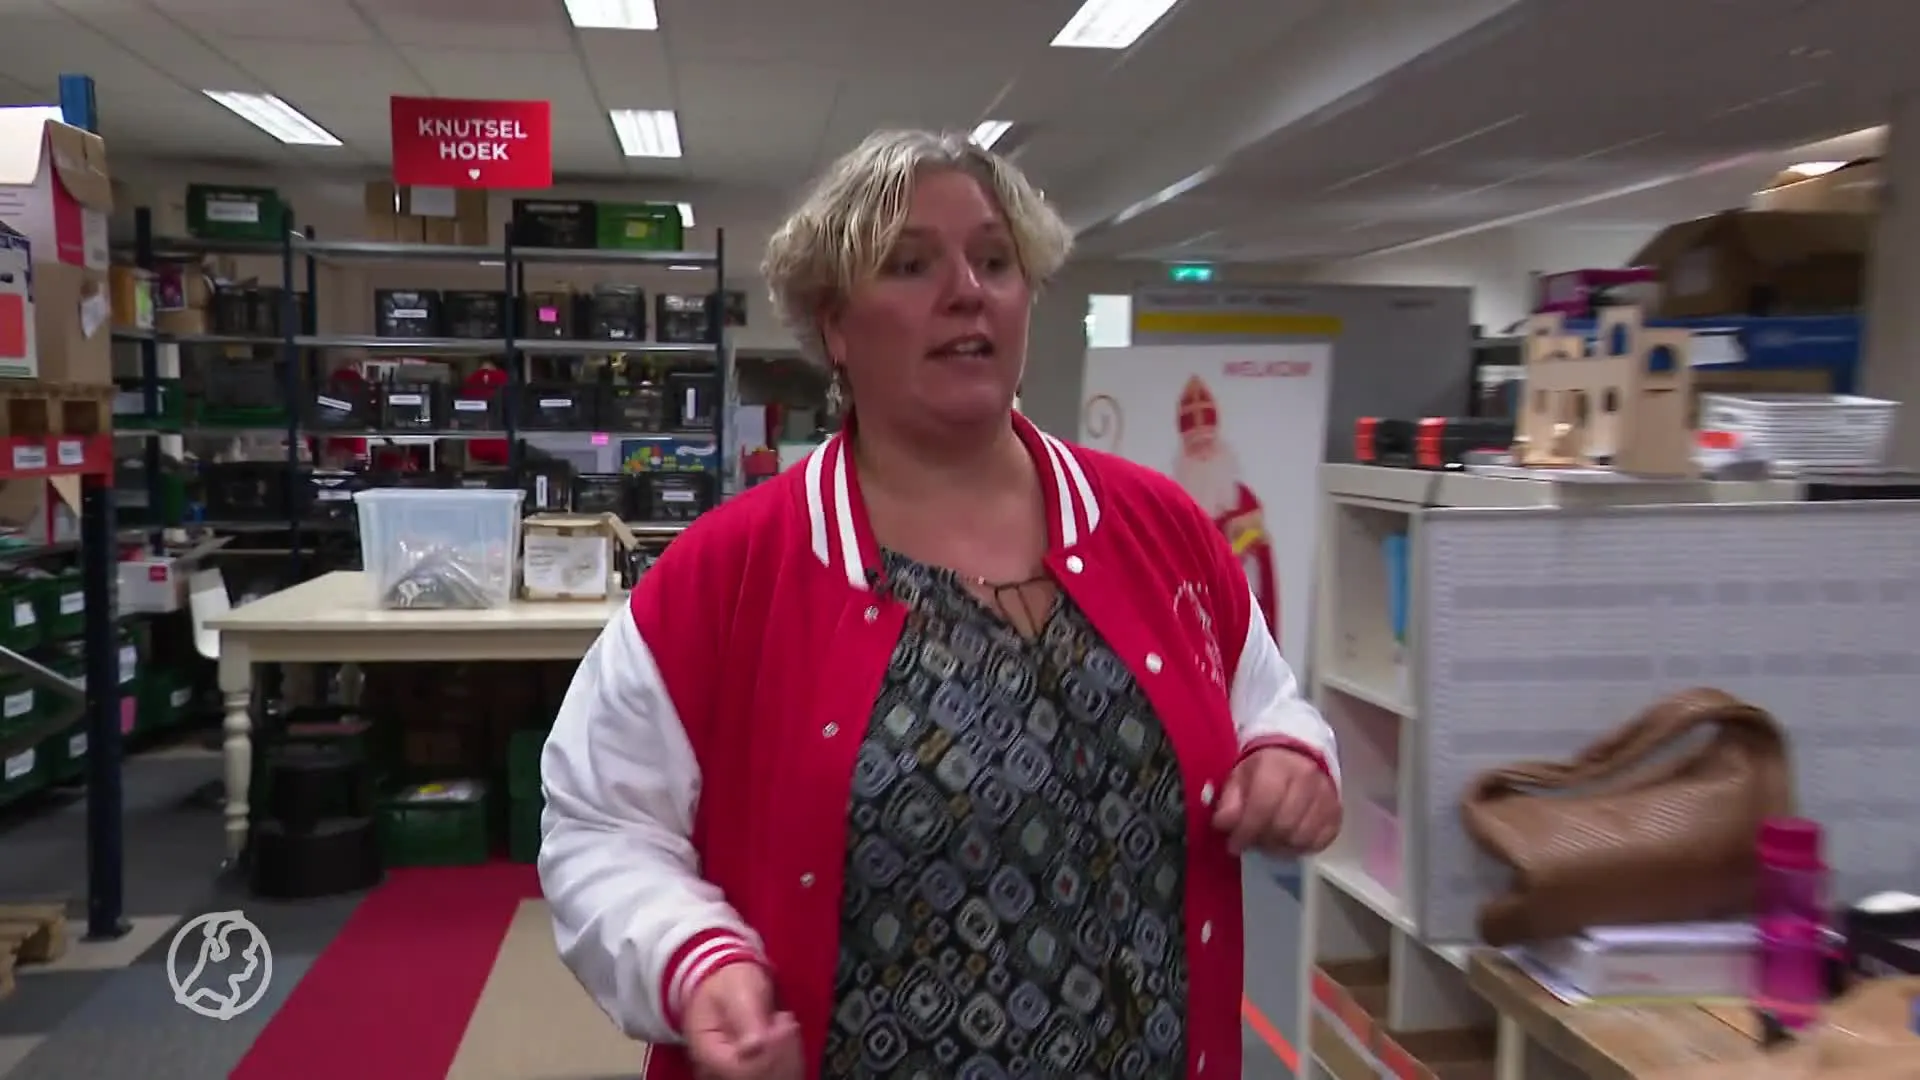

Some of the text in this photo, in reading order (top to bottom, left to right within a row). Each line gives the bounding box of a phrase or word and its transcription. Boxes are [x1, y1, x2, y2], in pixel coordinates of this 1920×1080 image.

[418, 117, 528, 139] KNUTSEL
[440, 141, 509, 160] HOEK
[1222, 361, 1313, 378] WELKOM
